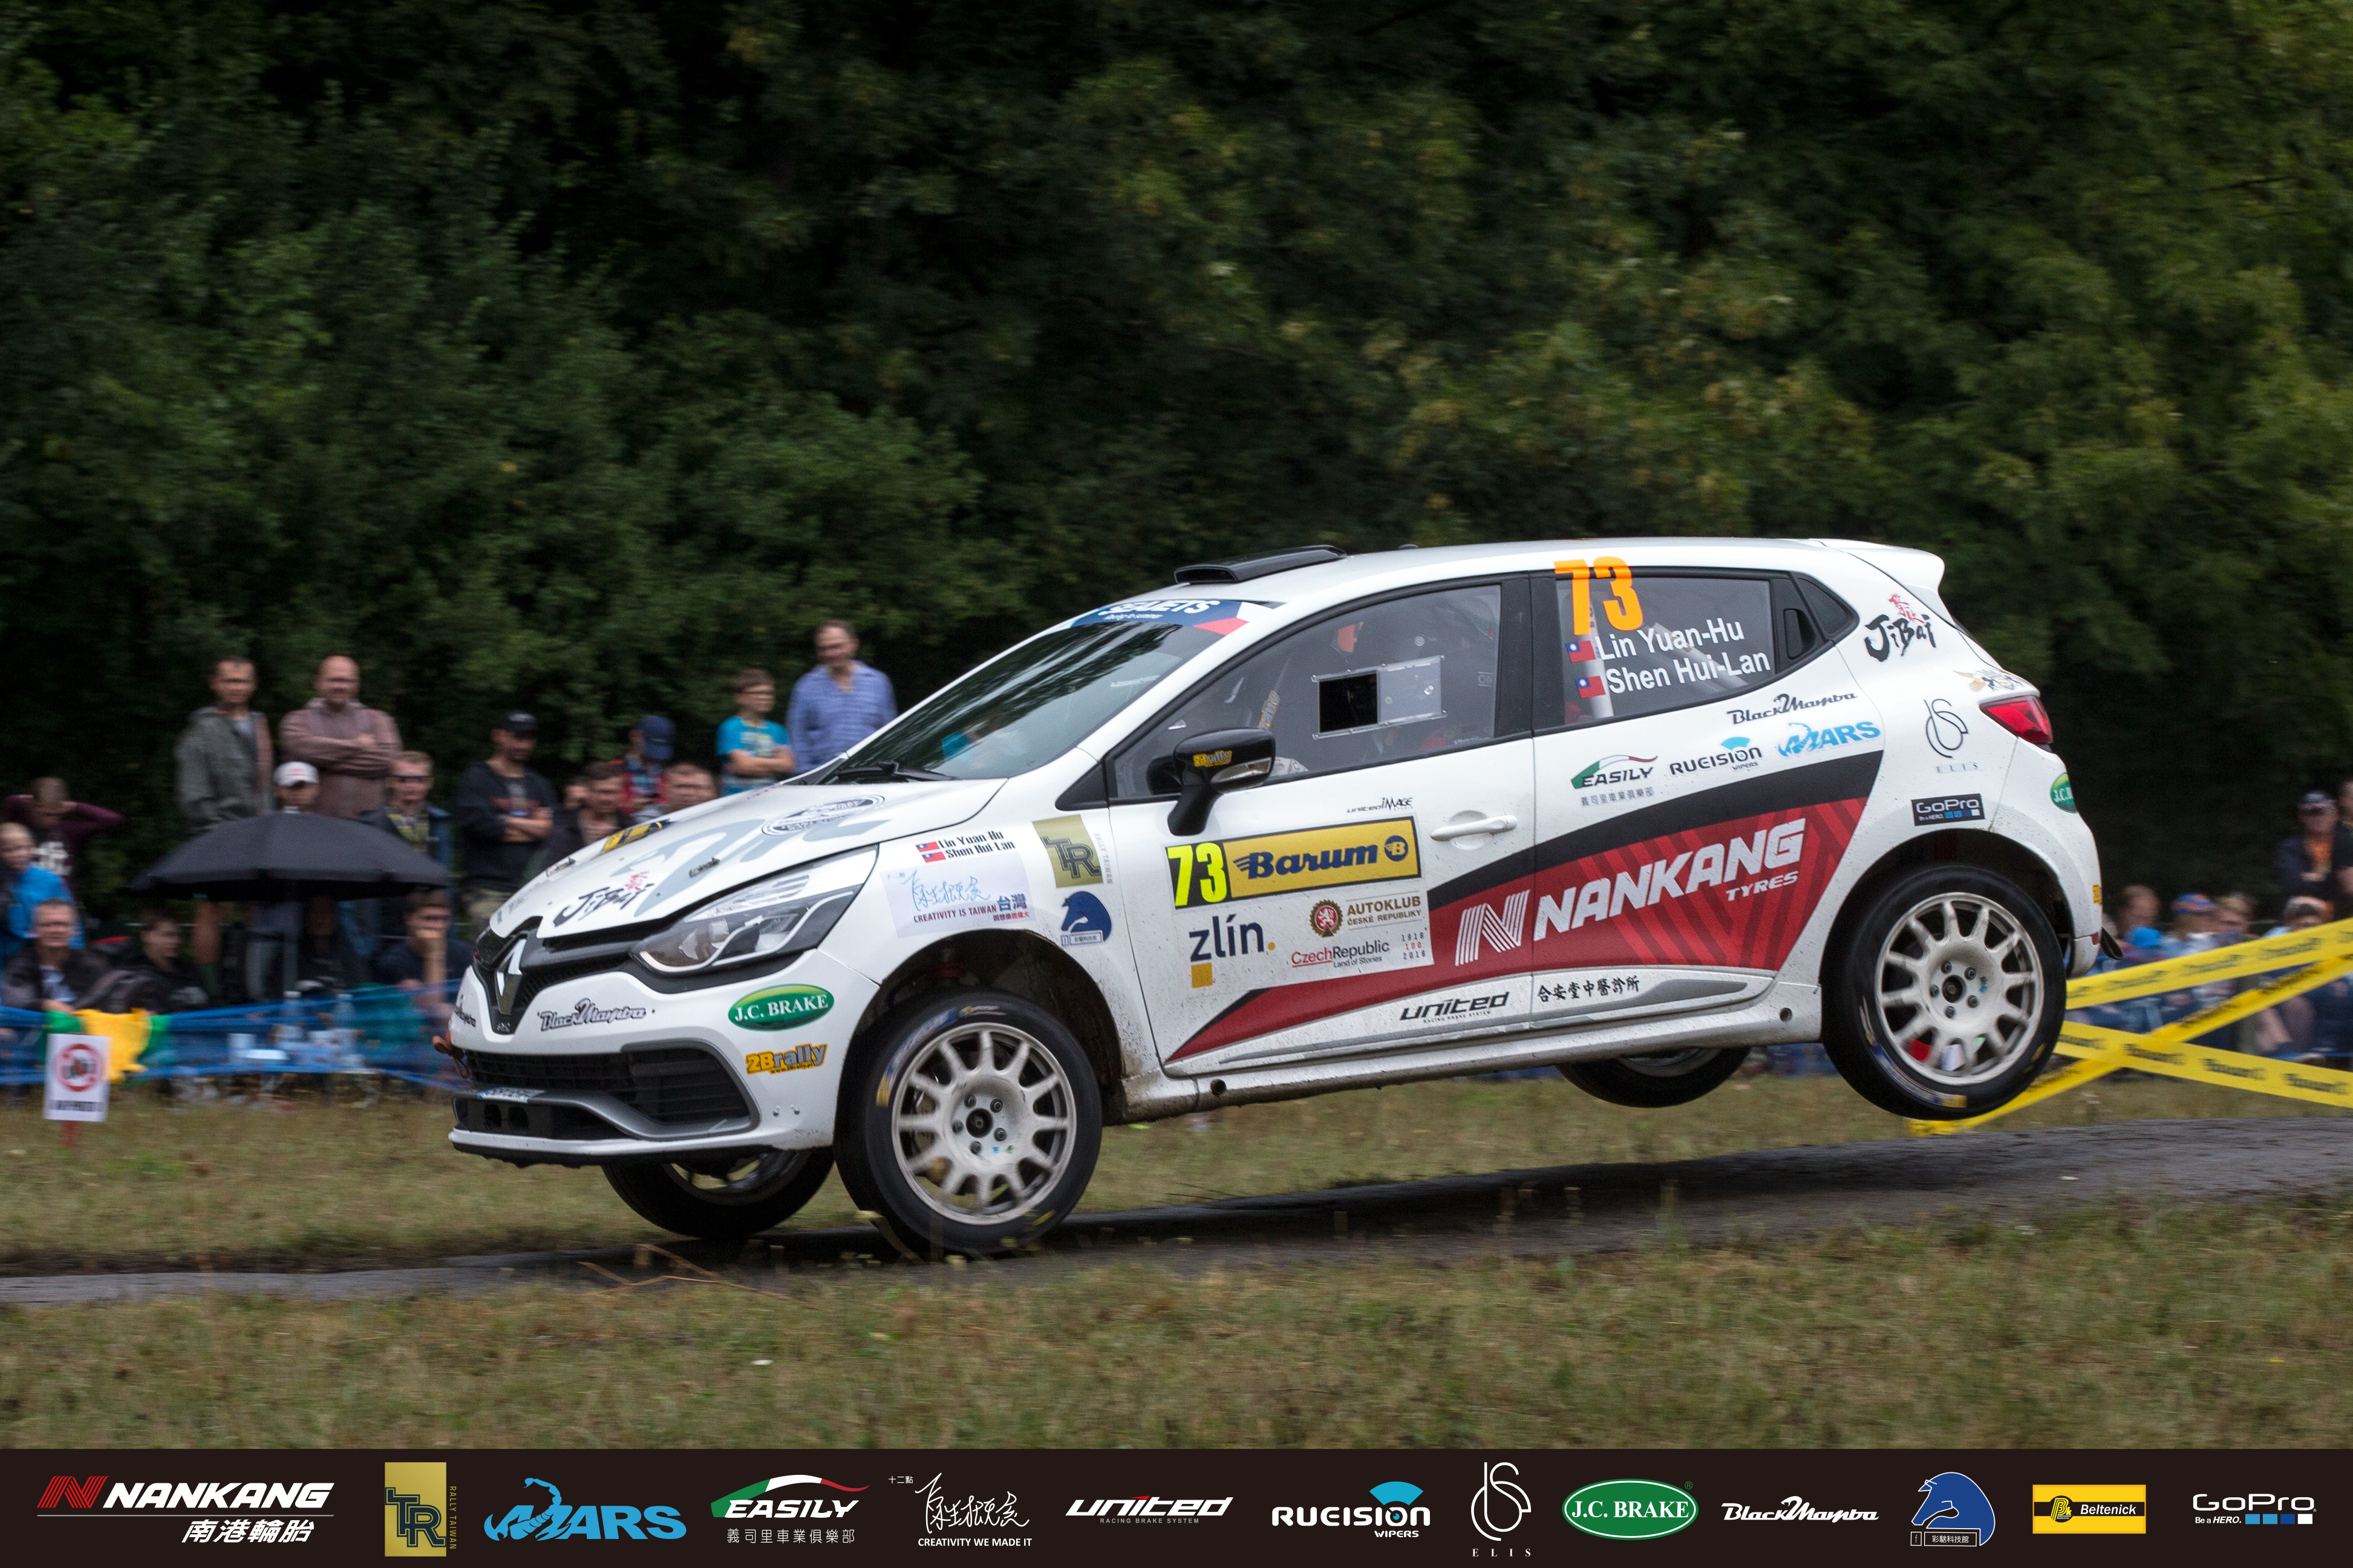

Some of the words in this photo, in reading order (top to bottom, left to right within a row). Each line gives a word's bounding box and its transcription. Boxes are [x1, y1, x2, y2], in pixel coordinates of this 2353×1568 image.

[1553, 556, 1643, 636] 73
[1594, 634, 1637, 660] Lin
[1637, 617, 1744, 654] Yuan-Hu
[1606, 665, 1671, 694] Shen
[1673, 651, 1771, 684] Hui-Lan
[1581, 767, 1654, 787] EASILY
[1916, 799, 1980, 813] GoPro
[938, 839, 956, 848] Lin
[956, 831, 1004, 845] Yuan-Hu
[945, 847, 974, 859] Shen
[974, 841, 1016, 854] Hui-Lan
[1167, 842, 1227, 906] 73
[1233, 844, 1378, 879] Barum
[1533, 818, 1806, 942] NANKANG
[1726, 871, 1798, 902] TYRES
[913, 909, 956, 923] CREATIVITY
[959, 908, 967, 917] IS
[968, 905, 997, 916] TAIWAN
[1347, 896, 1421, 916] AUTOKLUB
[1377, 909, 1421, 922] REPUBLIKY
[1333, 959, 1350, 968] Land
[1359, 955, 1382, 965] Stories
[735, 1005, 764, 1022] J.C.
[767, 995, 829, 1017] BRAKE
[1400, 992, 1510, 1020] united
[746, 1043, 828, 1075] 2Brally
